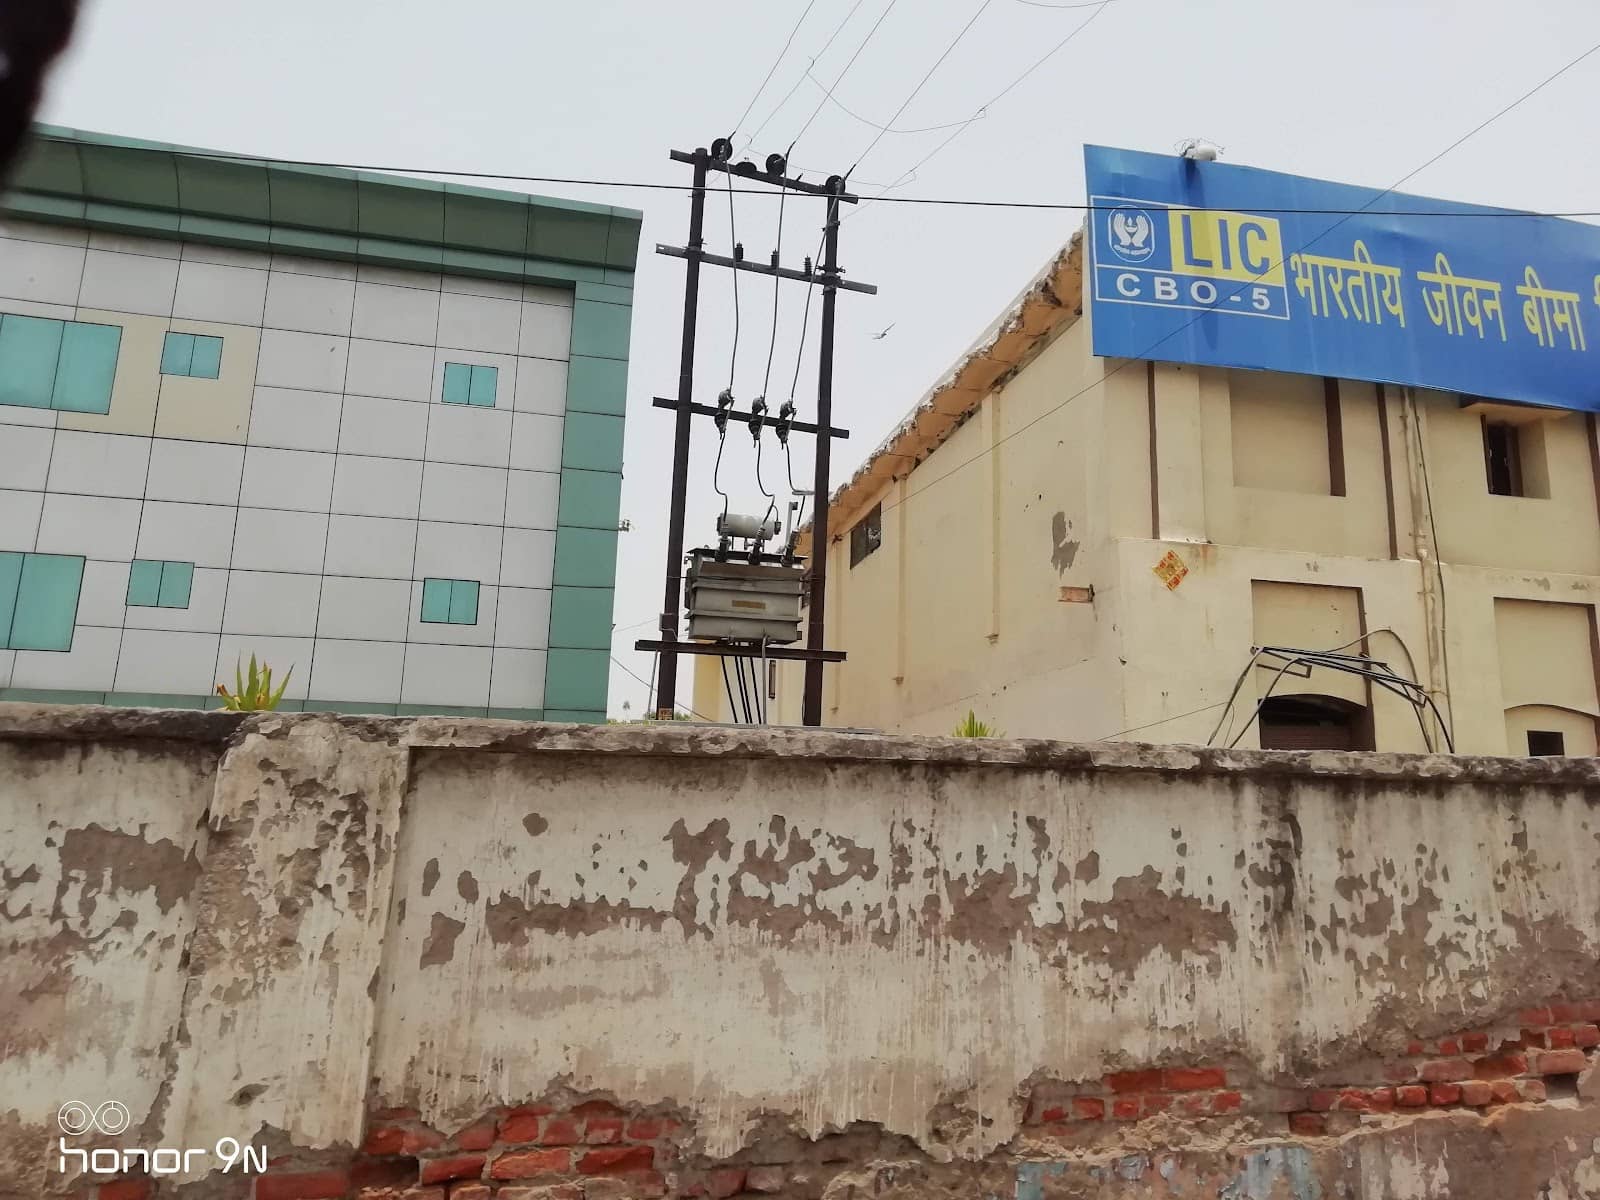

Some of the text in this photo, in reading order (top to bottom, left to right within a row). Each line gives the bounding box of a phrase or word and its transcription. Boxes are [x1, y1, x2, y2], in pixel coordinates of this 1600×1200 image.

[1181, 213, 1270, 275] LIC
[1290, 239, 1586, 351] भारतीय जीवन बीमा
